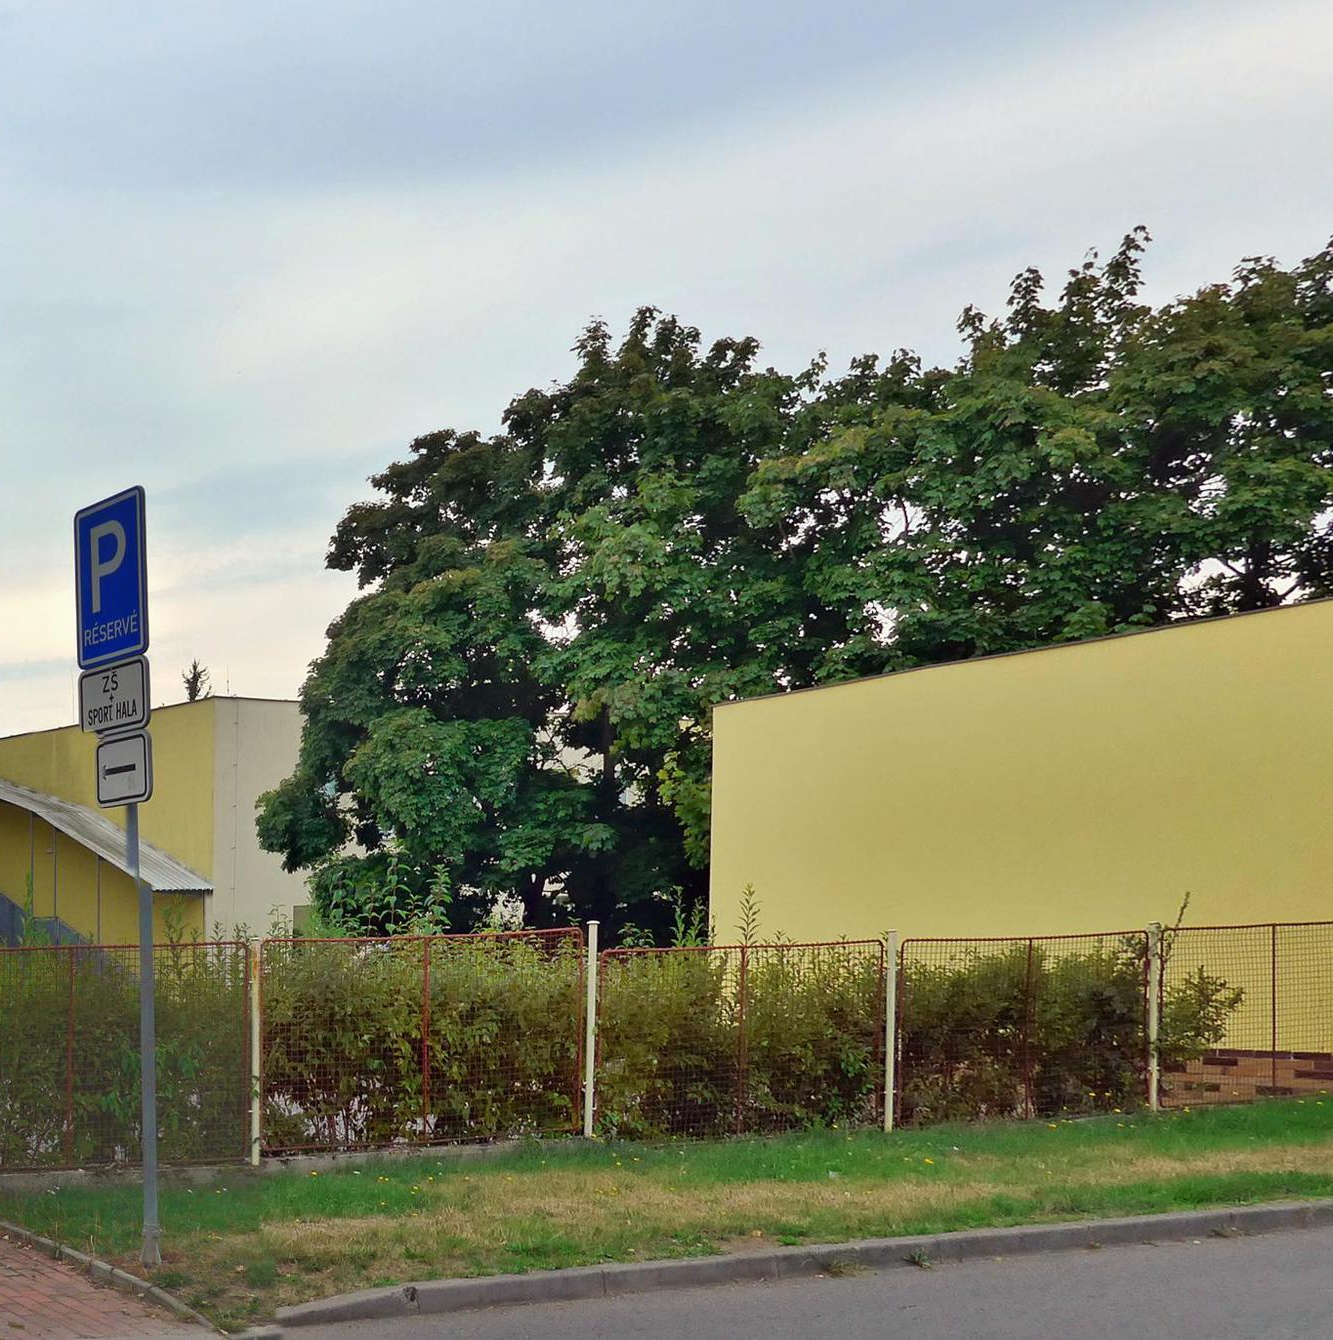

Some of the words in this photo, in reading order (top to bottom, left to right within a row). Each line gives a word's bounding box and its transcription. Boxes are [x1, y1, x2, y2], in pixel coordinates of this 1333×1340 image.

[90, 520, 126, 613] P
[85, 610, 138, 647] RÉSERVÉ
[102, 671, 119, 693] ZŠ
[116, 699, 137, 720] HALA
